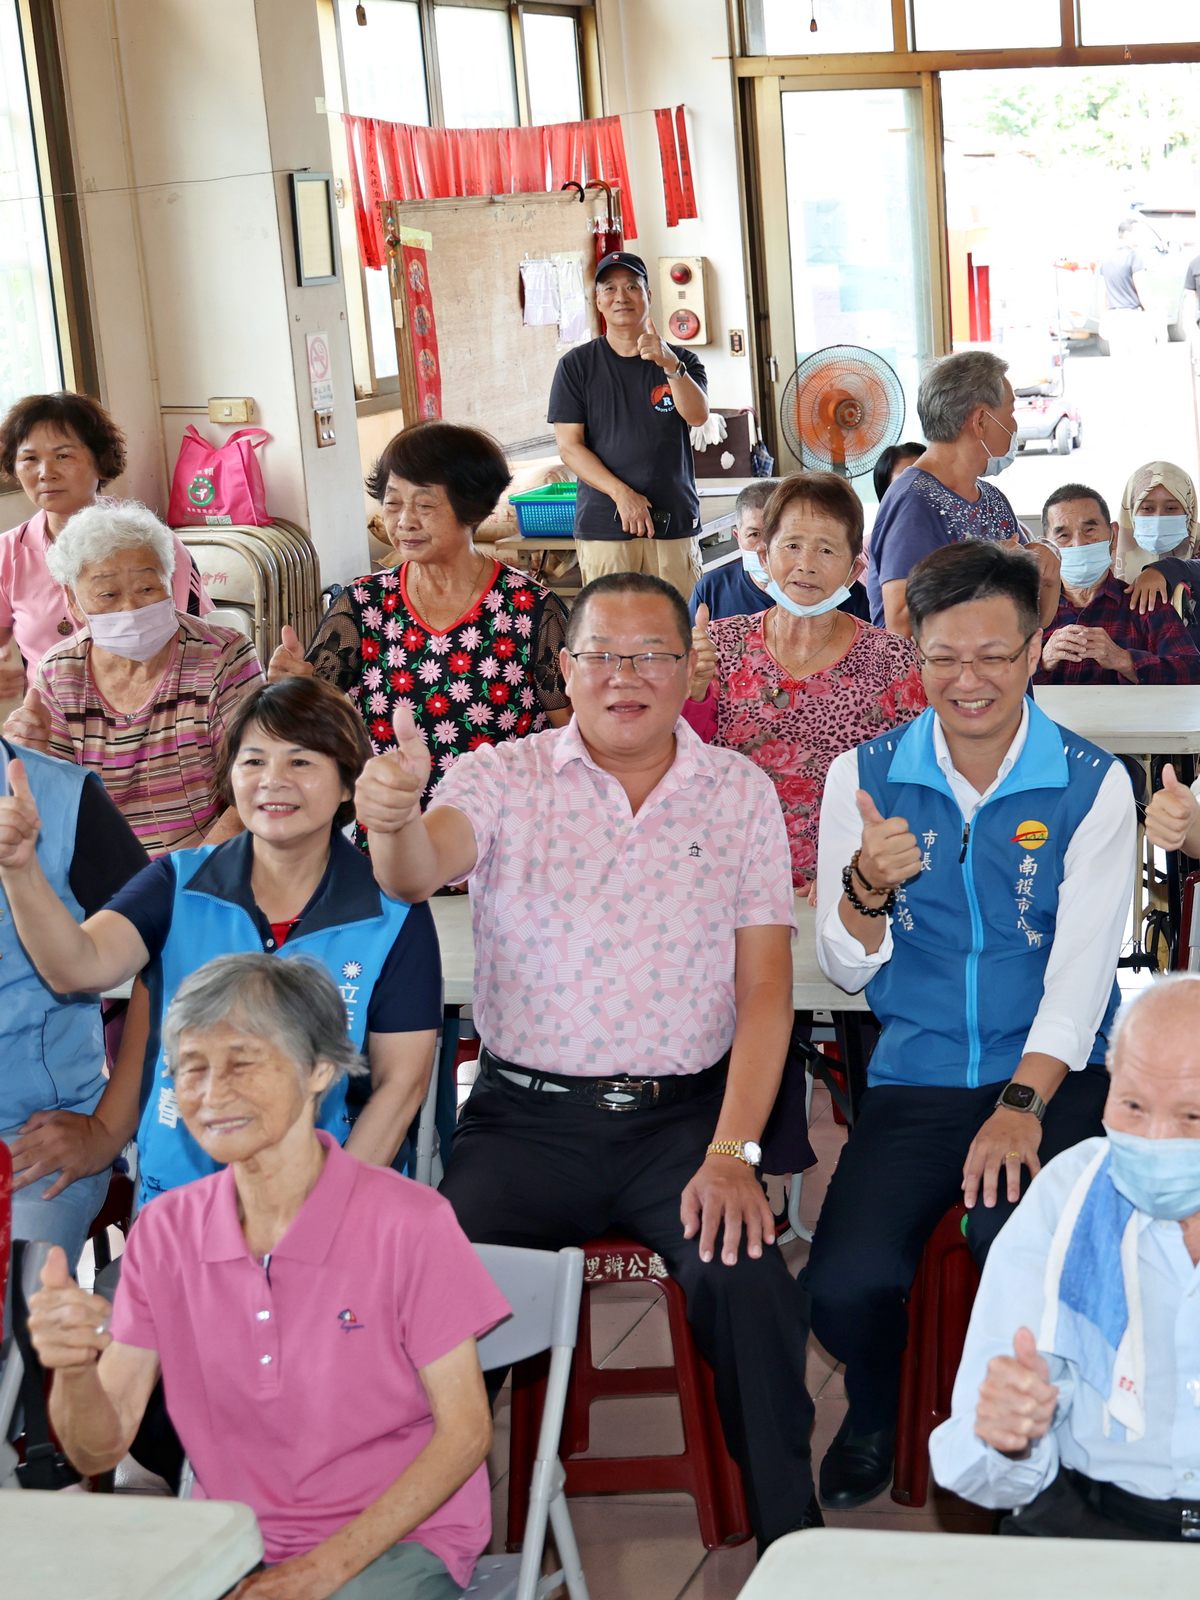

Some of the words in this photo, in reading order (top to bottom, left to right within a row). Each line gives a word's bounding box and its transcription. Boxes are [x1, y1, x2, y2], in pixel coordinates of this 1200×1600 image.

[663, 396, 672, 406] R
[920, 829, 939, 871] 市長
[1014, 854, 1044, 948] 南投市公所
